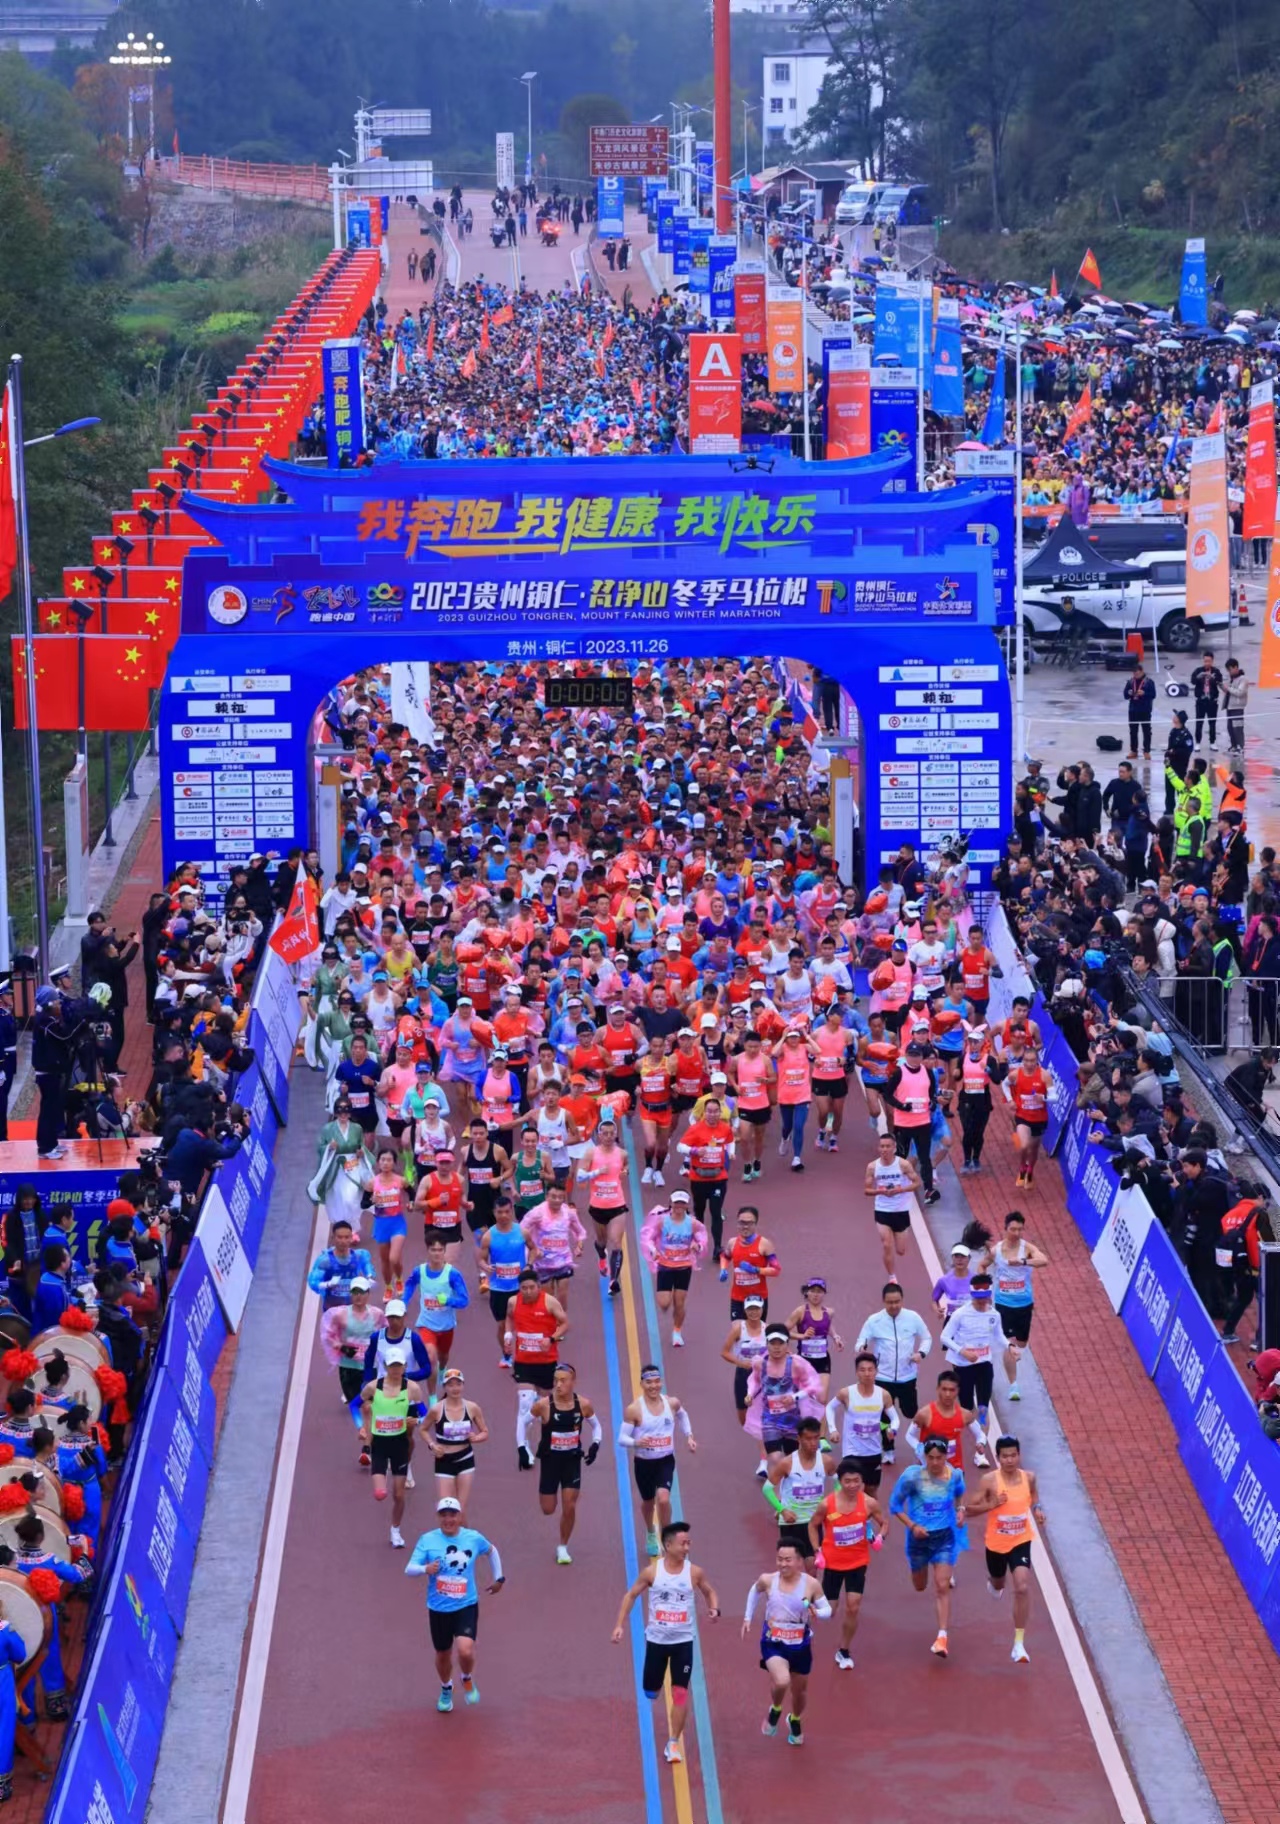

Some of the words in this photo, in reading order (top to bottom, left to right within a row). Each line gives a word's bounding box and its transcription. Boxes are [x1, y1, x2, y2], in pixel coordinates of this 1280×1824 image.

[594, 143, 648, 153] 九龙洞风景区
[594, 161, 648, 170] 朱砂古镇景区
[699, 343, 733, 377] A
[357, 499, 502, 558] 我奔跑
[515, 496, 662, 556] 我健康
[674, 493, 817, 555] 我快乐
[1062, 572, 1098, 582] POLICE
[854, 591, 917, 603] 梵净山马拉松
[1102, 600, 1127, 611] 公安
[309, 612, 355, 622] 跑遍中国
[438, 613, 464, 622] 2023
[468, 613, 517, 621] GUIZHOU
[521, 612, 577, 622] TONGREN,
[581, 611, 620, 619] MOUNT
[624, 610, 670, 619] FANJING
[674, 610, 716, 618] WINTER
[720, 609, 781, 618] MARATHON
[506, 640, 577, 656] 贵州·铜仁
[585, 640, 669, 654] 2023.11.26
[550, 683, 627, 703] 0:00:06
[922, 691, 954, 704] 赖祖
[215, 702, 246, 714] 赖祖
[1135, 1256, 1170, 1337] 铜仁市人民政府
[1167, 1316, 1204, 1404] 碧江区人民政府
[1194, 1386, 1241, 1484] 万山区人民政府
[163, 1409, 193, 1503] 万山区人民政府
[1232, 1460, 1280, 1566] 江口县人民政府
[147, 1485, 179, 1591] 江口县人民政府
